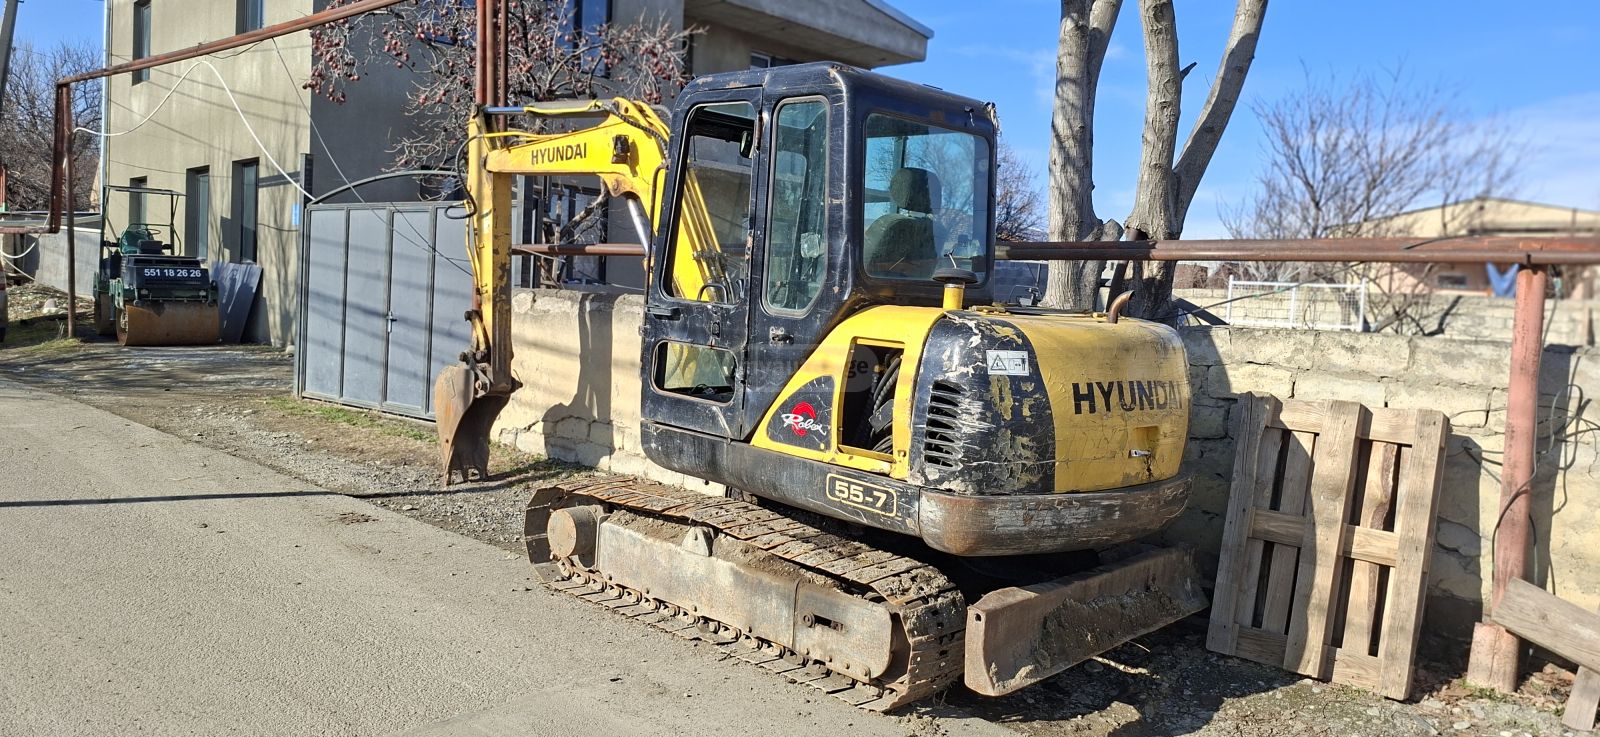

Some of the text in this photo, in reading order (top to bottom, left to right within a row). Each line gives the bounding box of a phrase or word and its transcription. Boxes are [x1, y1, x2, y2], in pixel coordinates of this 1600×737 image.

[531, 142, 587, 166] HYUNDAI
[144, 268, 202, 278] 551 18 26 26
[1071, 380, 1183, 415] HYUNDAI
[781, 413, 827, 436] Robex
[835, 480, 887, 508] 55-7
